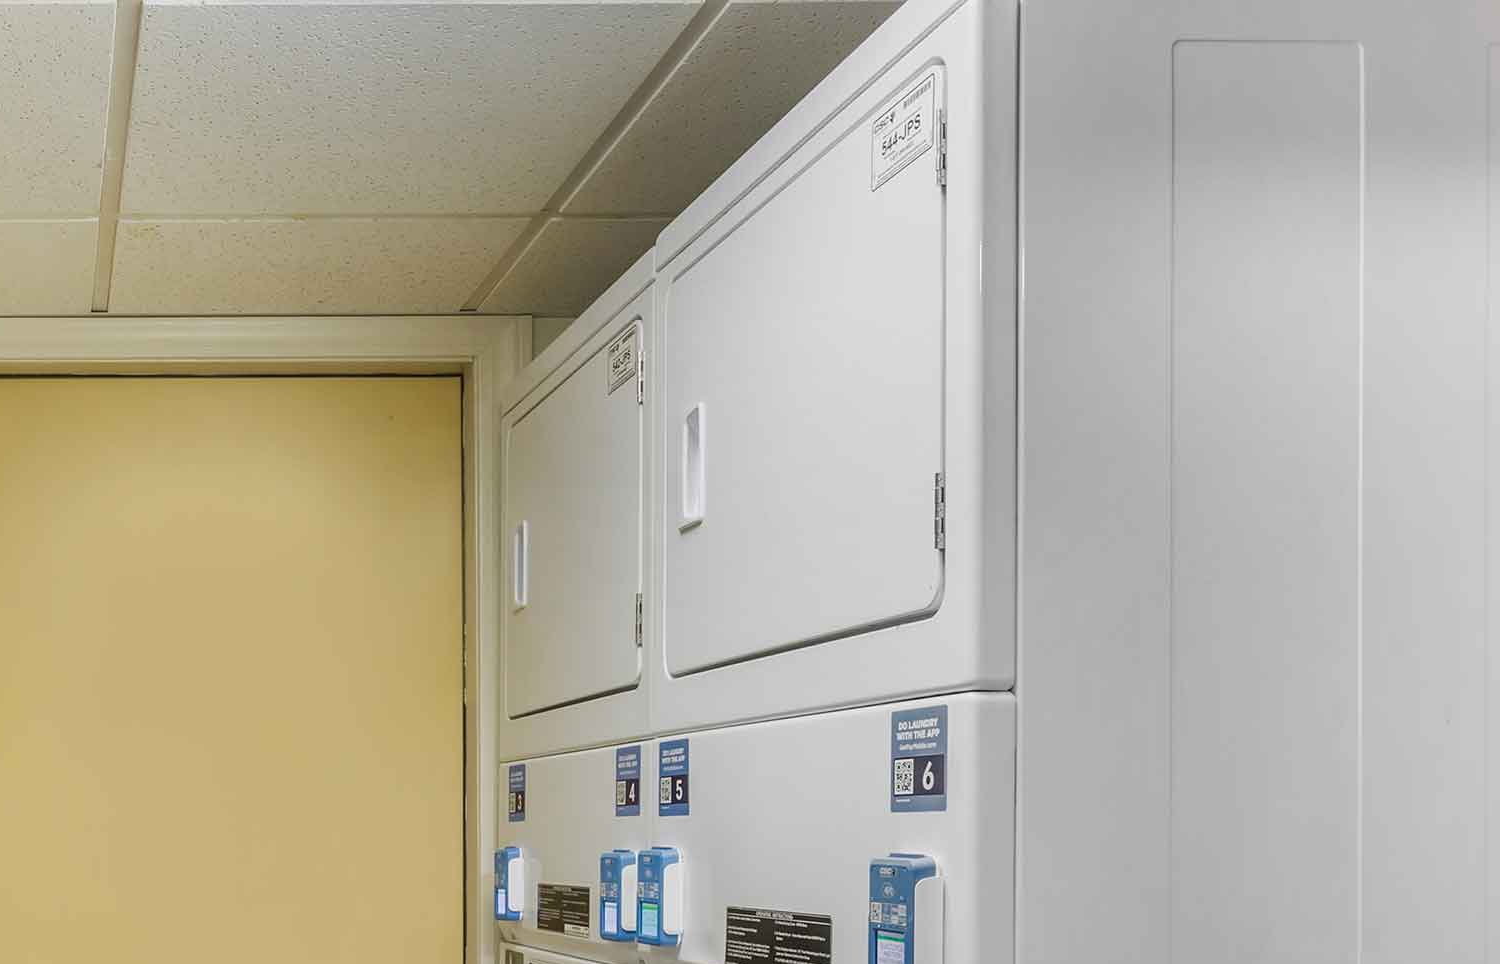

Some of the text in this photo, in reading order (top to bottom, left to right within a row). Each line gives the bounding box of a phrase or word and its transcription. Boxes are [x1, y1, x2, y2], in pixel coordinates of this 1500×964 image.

[882, 114, 921, 156] 544-JPS
[922, 761, 934, 790] 6
[628, 783, 635, 802] 4
[675, 779, 683, 801] 5
